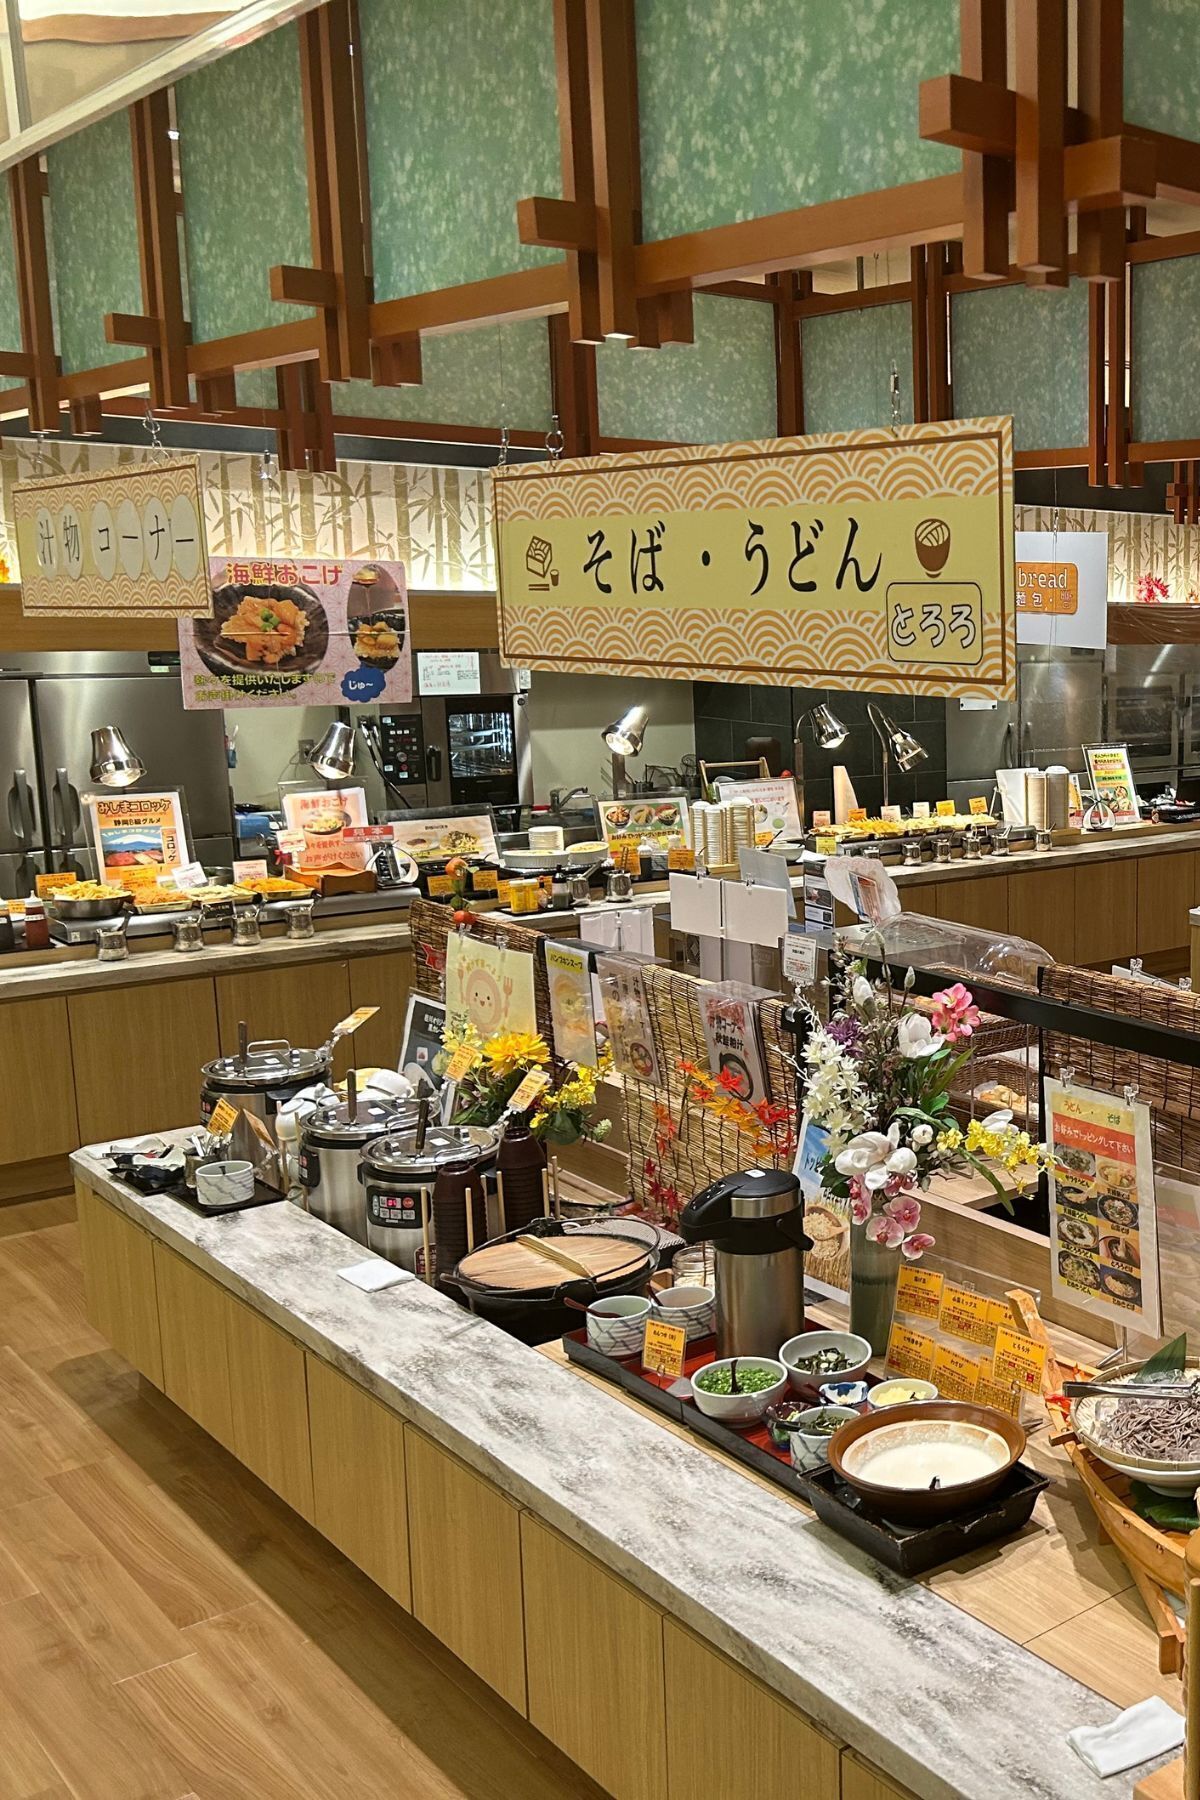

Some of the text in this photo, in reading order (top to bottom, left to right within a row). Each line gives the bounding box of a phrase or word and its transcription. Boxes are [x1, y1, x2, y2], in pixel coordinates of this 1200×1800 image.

[583, 517, 882, 596] そば・うどん
[226, 562, 343, 586] 海鮮おこげ
[1018, 567, 1067, 589] bread
[891, 603, 977, 649] とろろ
[98, 799, 172, 815] みしまコロッケ
[166, 835, 177, 862] コロッケ
[1054, 1121, 1134, 1155] お好みでトッピングして下さい
[1012, 1341, 1031, 1355] とろろ汁
